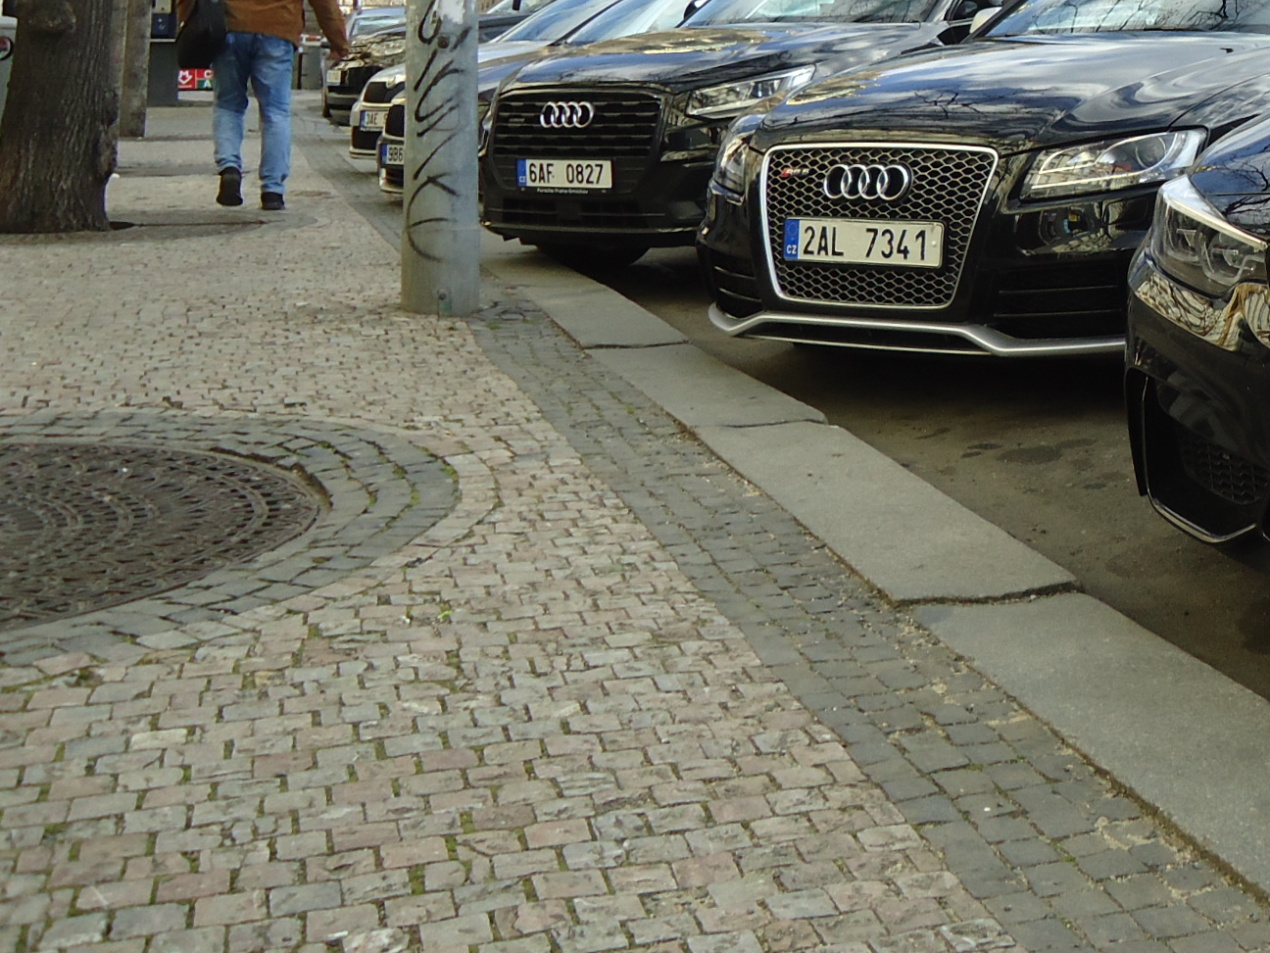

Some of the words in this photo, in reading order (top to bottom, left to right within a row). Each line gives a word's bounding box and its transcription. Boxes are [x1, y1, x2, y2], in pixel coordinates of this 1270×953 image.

[529, 163, 554, 184] 6AF
[566, 163, 604, 184] 0827
[786, 244, 797, 254] CZ
[803, 226, 844, 256] 2AL
[866, 228, 927, 260] 7341
